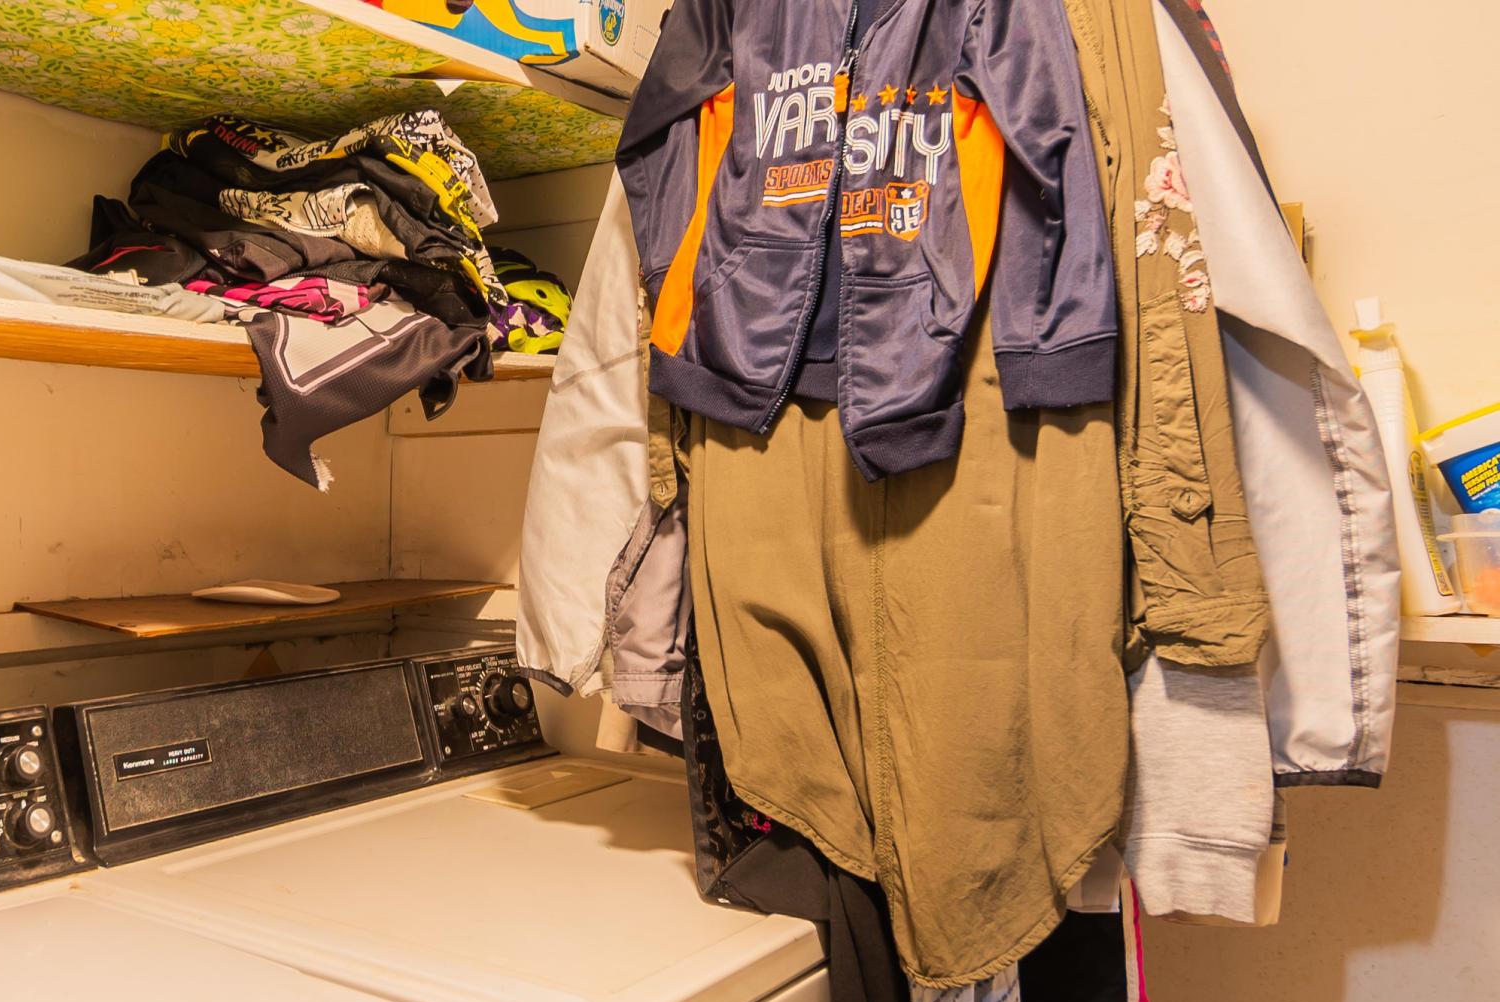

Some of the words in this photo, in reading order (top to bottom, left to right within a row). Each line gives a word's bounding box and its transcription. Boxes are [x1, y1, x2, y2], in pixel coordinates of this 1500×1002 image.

[768, 62, 831, 92] JUNIOR
[754, 86, 952, 186] VARSITY
[765, 159, 834, 190] SPORTS
[841, 188, 884, 217] DEPT
[122, 758, 155, 770] Kenmore
